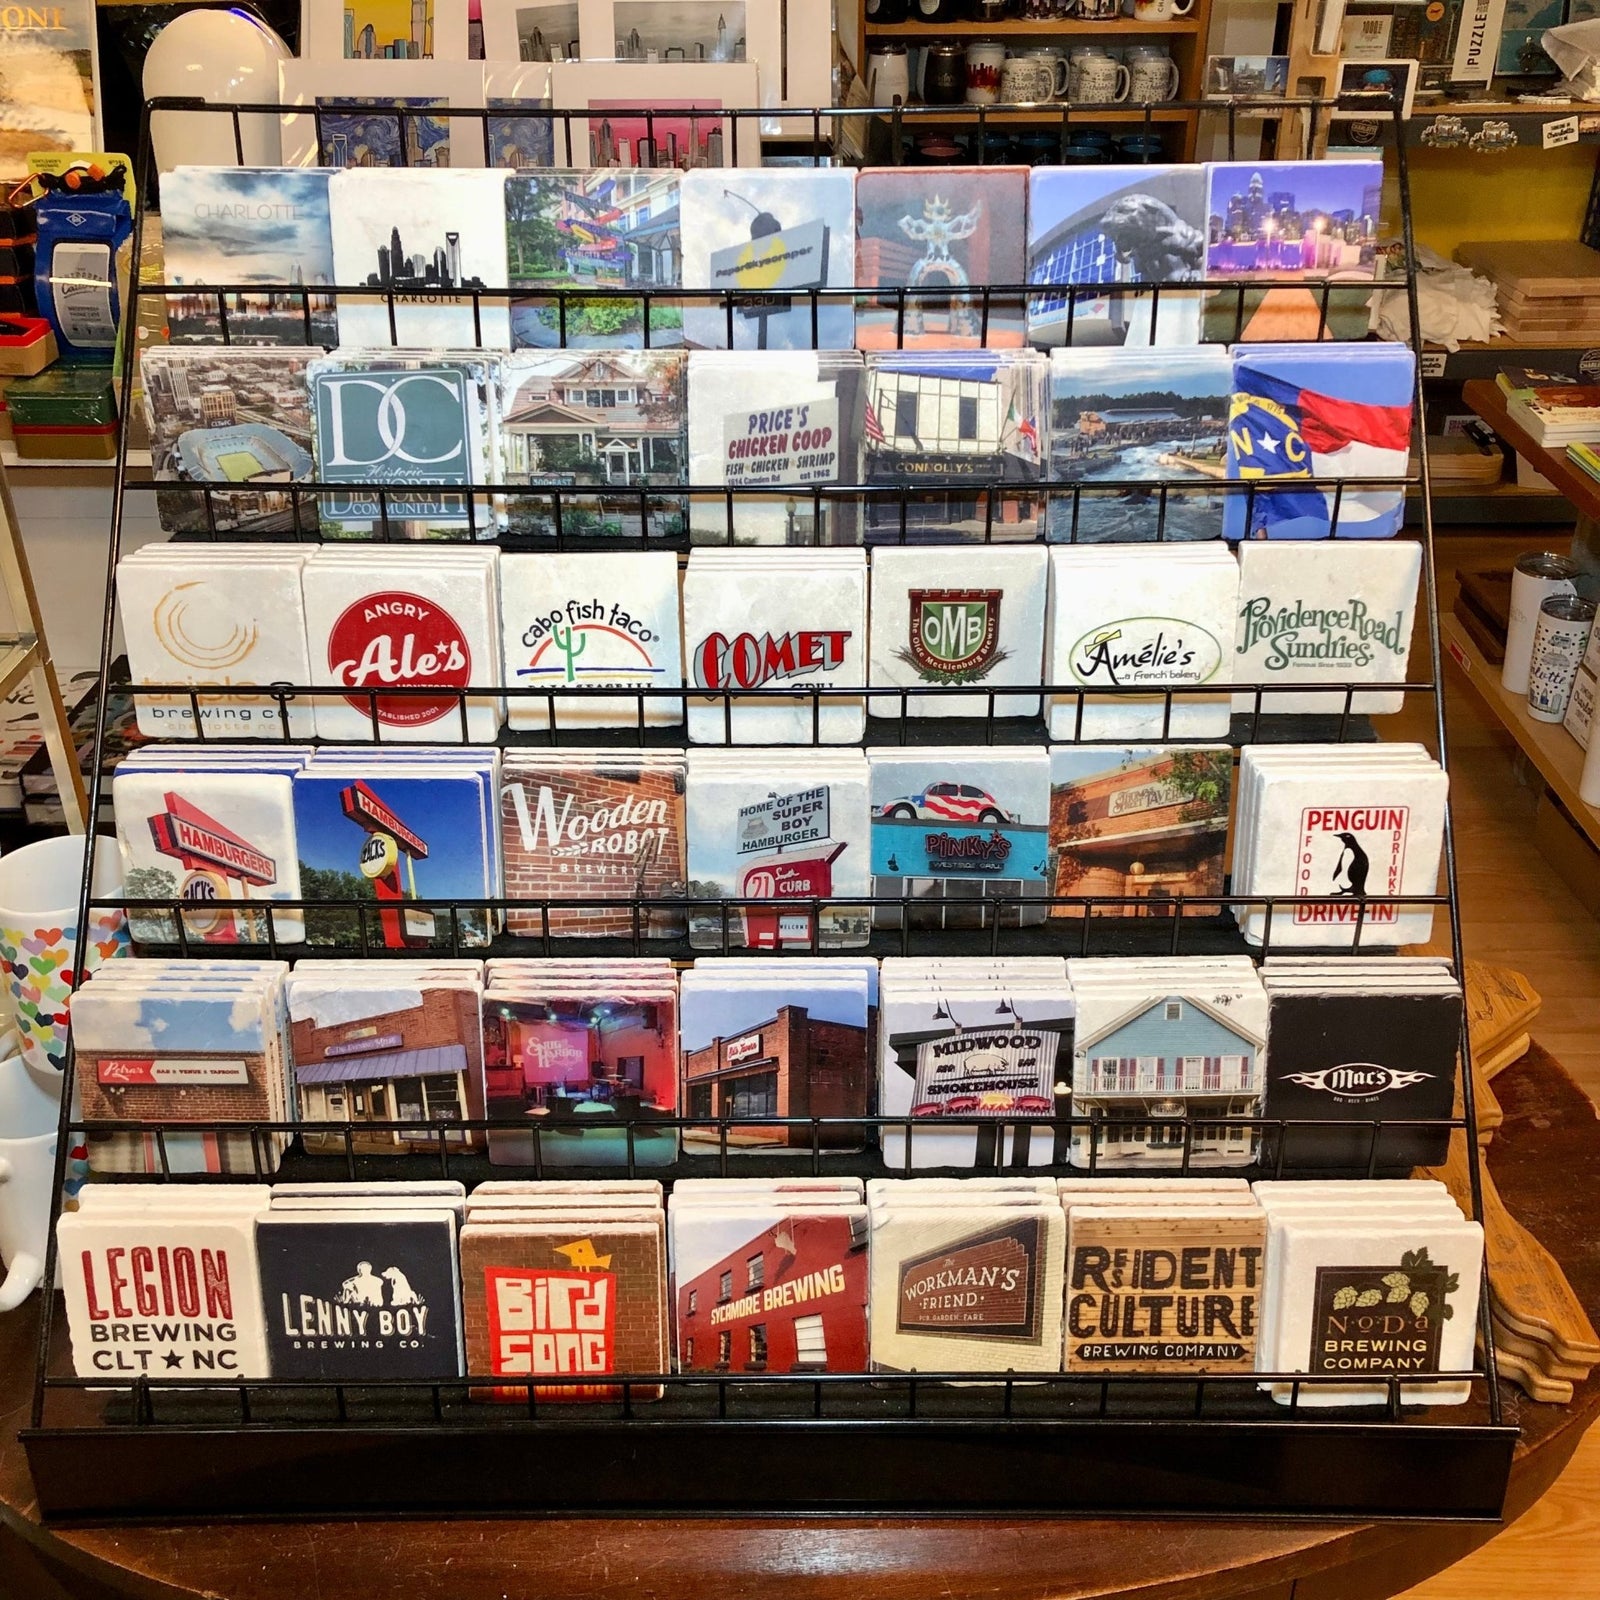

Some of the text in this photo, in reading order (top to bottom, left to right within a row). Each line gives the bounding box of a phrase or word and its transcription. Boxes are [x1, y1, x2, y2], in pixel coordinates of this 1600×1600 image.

[1467, 14, 1487, 65] PUZZLE
[194, 203, 304, 220] CHARLOTTE
[749, 405, 809, 434] PRICE'S
[728, 427, 832, 459] CHICKEN COOP
[1229, 427, 1306, 462] N C
[726, 452, 835, 476] FISH CHICKEN SHRIMP
[896, 462, 974, 473] CONNOLLY'S
[744, 475, 770, 485] Camden
[772, 473, 780, 481] Rd
[363, 602, 430, 623] ANGRY
[522, 610, 563, 647] cabo
[566, 599, 605, 625] fish
[925, 606, 982, 656] OMB
[1236, 597, 1406, 655] Providence Road
[913, 636, 925, 657] Olde
[926, 655, 983, 671] Mecklenburg
[981, 617, 995, 653] Brewery
[694, 631, 852, 700] COMET
[1077, 632, 1196, 685] Amélie's
[1134, 671, 1168, 681] French
[1170, 670, 1201, 681] bakery
[152, 707, 251, 720] brewing
[421, 706, 440, 718] 2001
[740, 787, 825, 817] HOME OF THE
[773, 800, 823, 820] SUPER
[362, 797, 427, 853] HAMBURGERS
[501, 783, 667, 851] Wooden
[782, 816, 812, 832] BOY
[1307, 809, 1404, 831] PENGUIN
[179, 823, 272, 877] HAMBURGERS
[591, 828, 669, 854] ROBOT
[742, 827, 819, 851] HAMBURGER
[560, 863, 639, 875] BREWERY
[1300, 836, 1313, 896] FOOD
[780, 880, 810, 893] CURB
[1299, 903, 1393, 922] DRIVE-IN
[933, 1035, 1042, 1057] MIDWOOD
[927, 1077, 1039, 1095] SMOKEHOUSE
[1332, 1069, 1386, 1089] Mac's
[81, 1246, 233, 1320] LEGION
[711, 1264, 846, 1325] SYCAMORE BREWING
[905, 1266, 1020, 1301] WORKMAN'S
[922, 1292, 978, 1309] FRIEND
[282, 1292, 430, 1337] LENNY BOY
[1068, 1294, 1255, 1339] CULTURE
[90, 1323, 237, 1343] BREWING
[294, 1340, 425, 1349] BREWING CO.
[1083, 1344, 1238, 1358] BREWING COMPANY
[1324, 1340, 1427, 1352] BREWING
[92, 1349, 239, 1371] CLT NC
[1323, 1358, 1425, 1369] COMPANY
